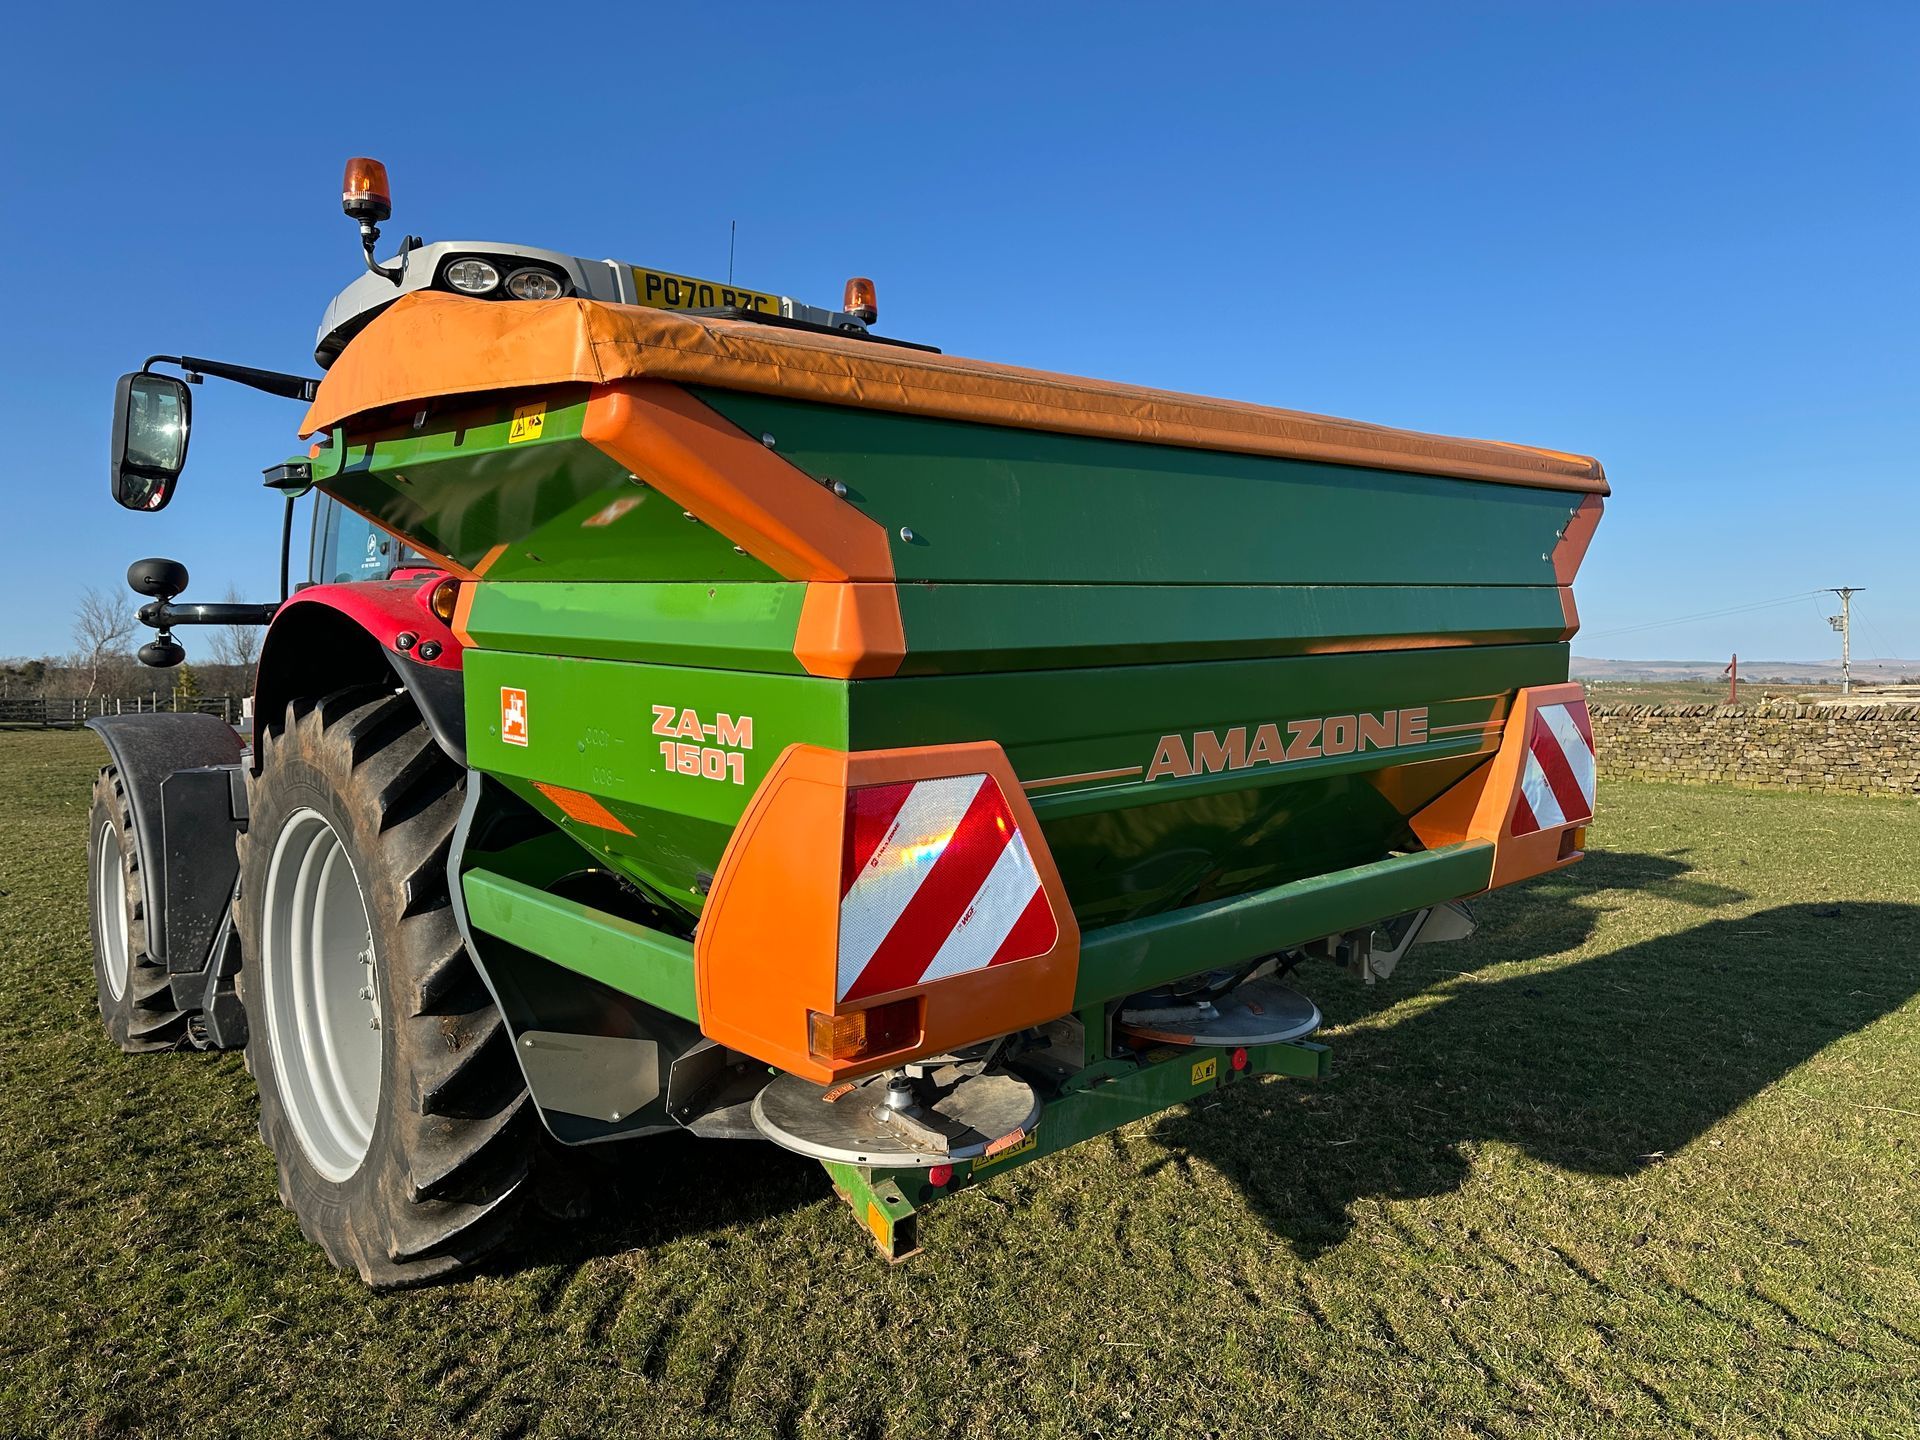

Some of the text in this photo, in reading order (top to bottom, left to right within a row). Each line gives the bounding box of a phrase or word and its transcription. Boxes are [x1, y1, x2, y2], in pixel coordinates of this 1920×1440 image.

[652, 704, 753, 749] ZA-M
[1145, 707, 1428, 782] AMAZONE
[660, 741, 744, 785] 1501
